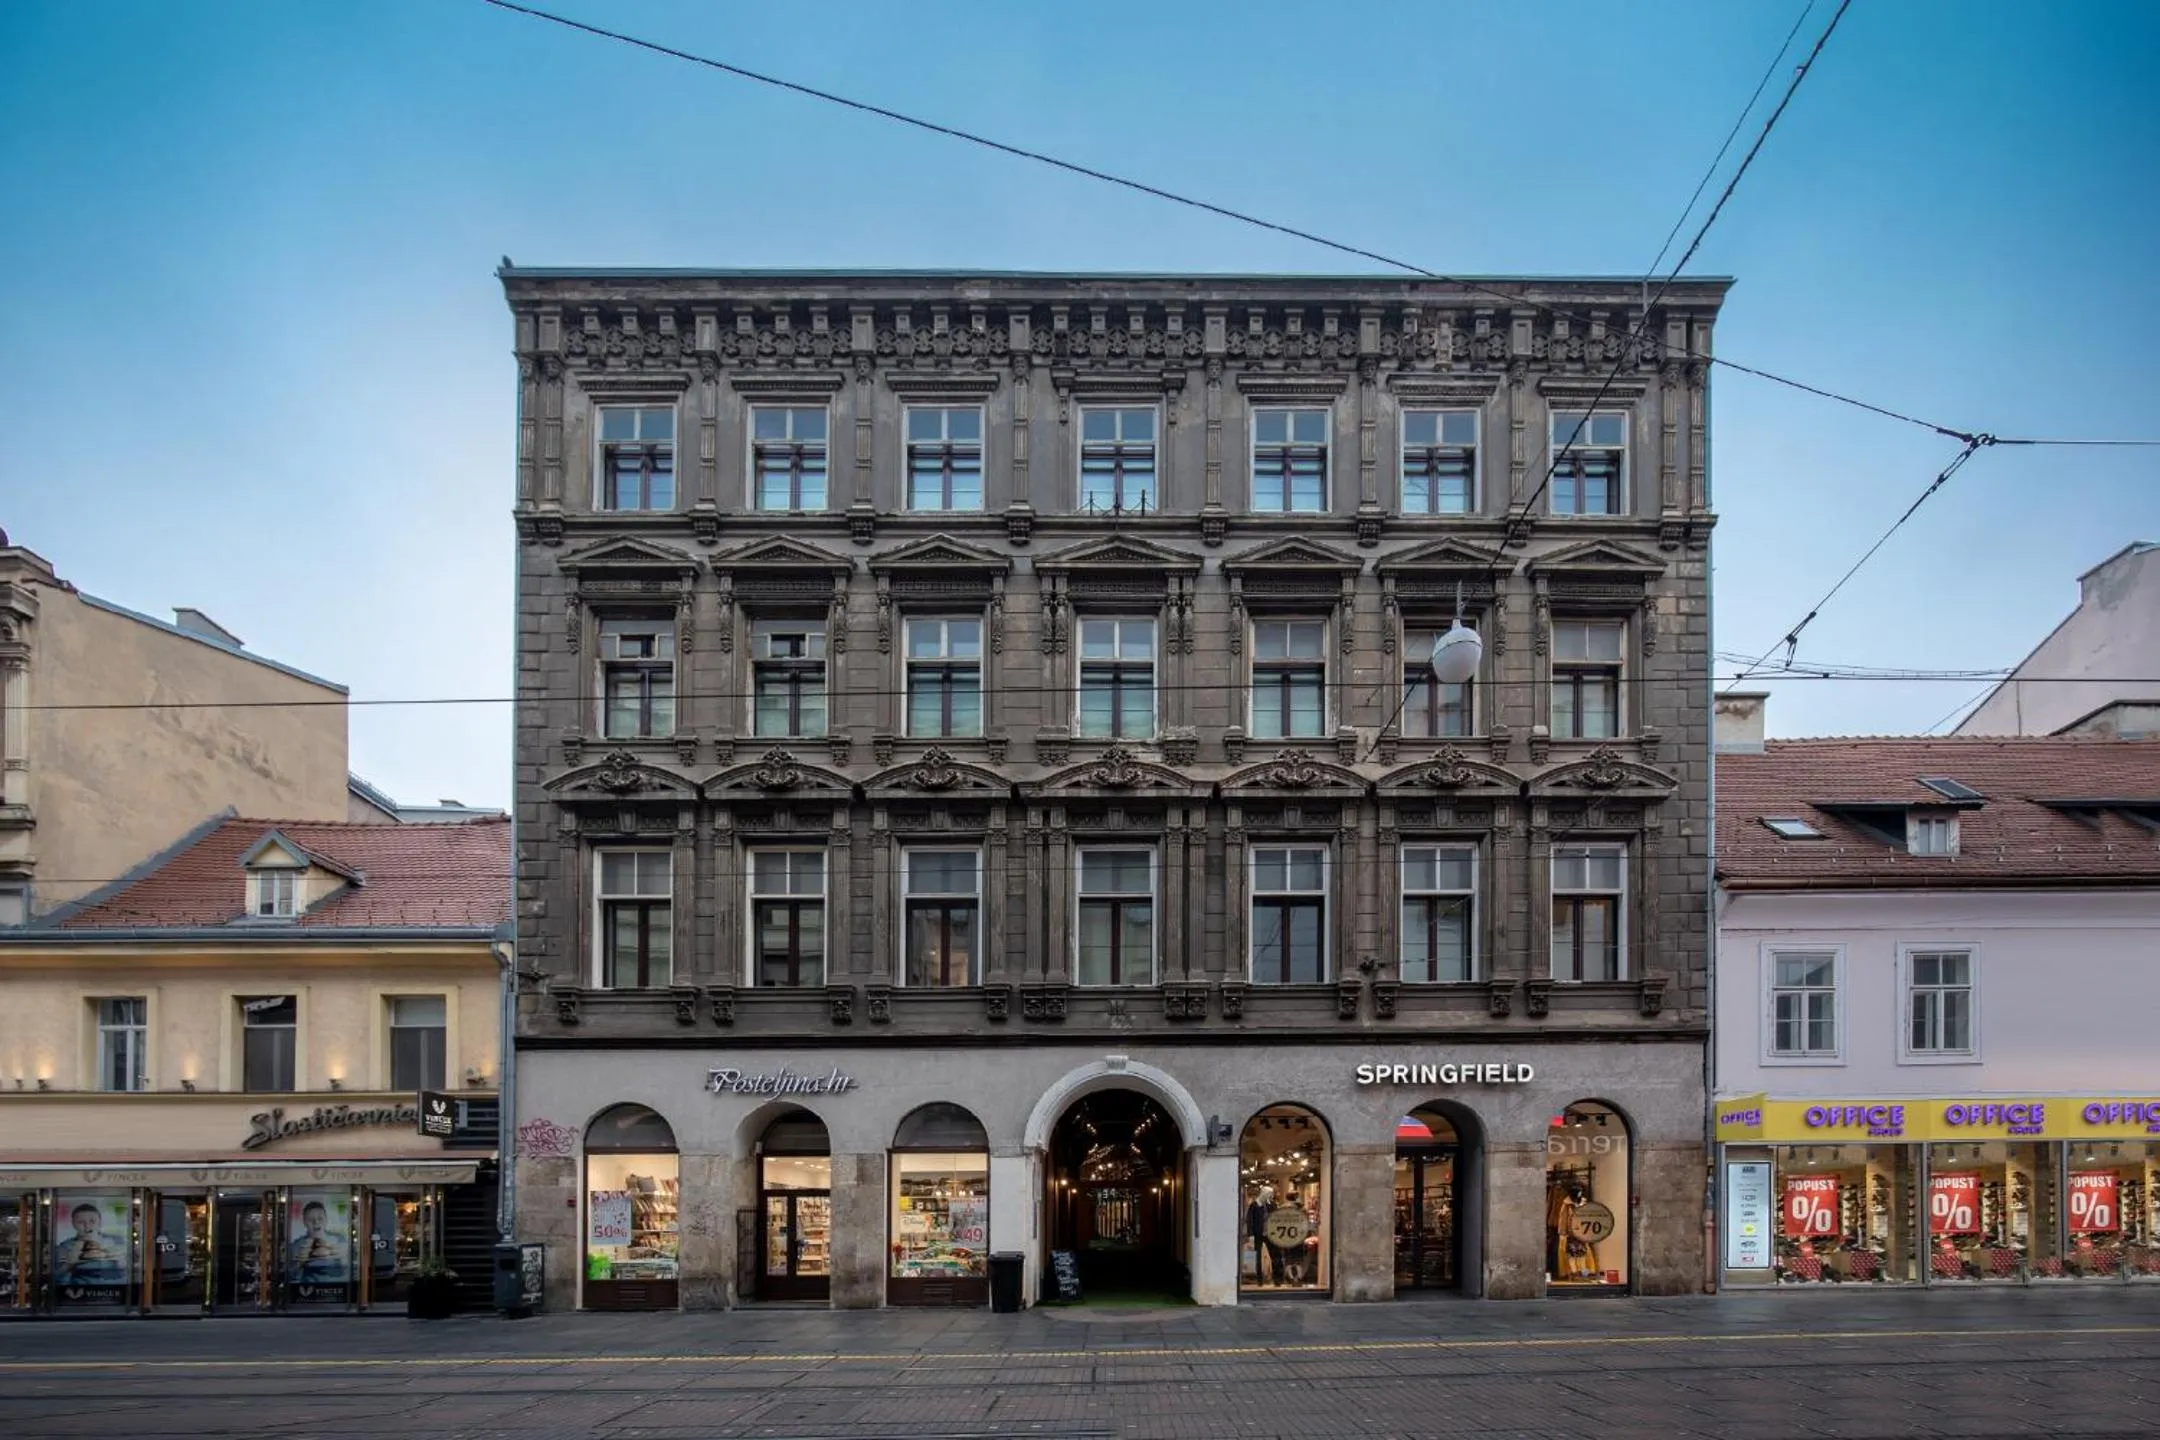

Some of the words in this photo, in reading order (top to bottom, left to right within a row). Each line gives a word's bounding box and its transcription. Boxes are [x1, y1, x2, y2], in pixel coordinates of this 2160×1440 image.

[708, 1067, 849, 1101] Posteljina.hr
[1356, 1063, 1535, 1085] SPRINGFIELD
[241, 1103, 419, 1150] Slastičarnic
[1719, 1109, 1761, 1125] OFFICE
[1804, 1105, 1905, 1128] OFFICE
[1944, 1104, 2045, 1125] OFFICE
[1787, 1180, 1836, 1191] POPUST
[1792, 1195, 1832, 1233] %
[1932, 1193, 1972, 1231] %
[2071, 1191, 2110, 1228] %
